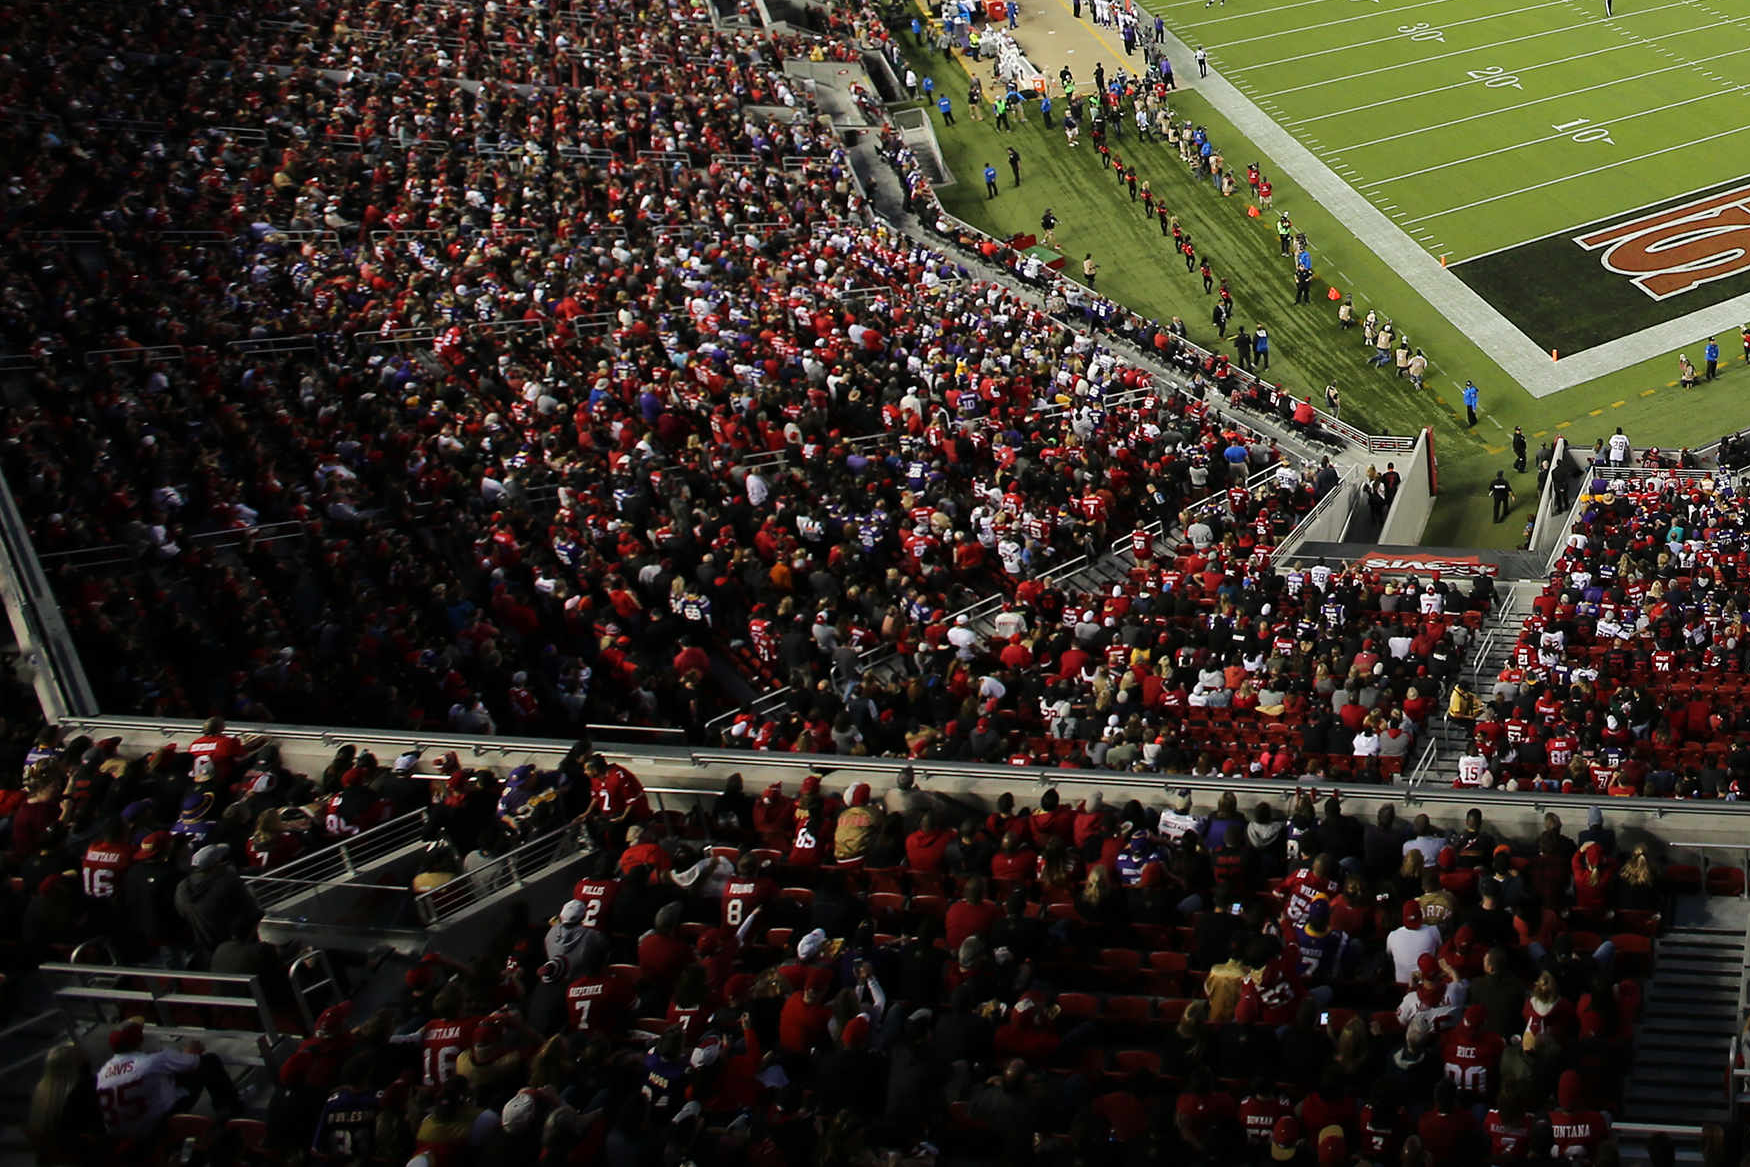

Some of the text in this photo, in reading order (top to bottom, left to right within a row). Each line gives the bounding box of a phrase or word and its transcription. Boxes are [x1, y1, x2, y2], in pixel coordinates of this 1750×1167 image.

[1396, 21, 1438, 42] 30
[1466, 65, 1517, 90] 20
[1552, 117, 1608, 144] 10
[1612, 440, 1623, 451] 28
[1389, 477, 1394, 488] 7
[1233, 495, 1241, 506] 7
[1088, 503, 1095, 515] 7
[1566, 561, 1573, 571] 7
[1312, 572, 1325, 583] 28
[1426, 603, 1433, 614] 7
[1518, 654, 1528, 665] 21
[1655, 662, 1669, 672] 74
[1550, 750, 1572, 765] 80
[1464, 766, 1478, 781] 15
[598, 790, 611, 812] 7
[254, 851, 270, 868] 7
[82, 850, 120, 898] MONTANA 16
[1300, 884, 1320, 897] WILL
[581, 884, 605, 927] WILLIS 2
[727, 899, 743, 926] 8
[1302, 956, 1320, 976] 7
[574, 999, 593, 1030] 7
[677, 1016, 691, 1032] 7
[1456, 1046, 1476, 1059] RICE
[105, 1060, 135, 1079] DAVIS
[423, 1046, 461, 1086] 16
[648, 1072, 670, 1088] MOSS
[1502, 1138, 1517, 1156] 7
